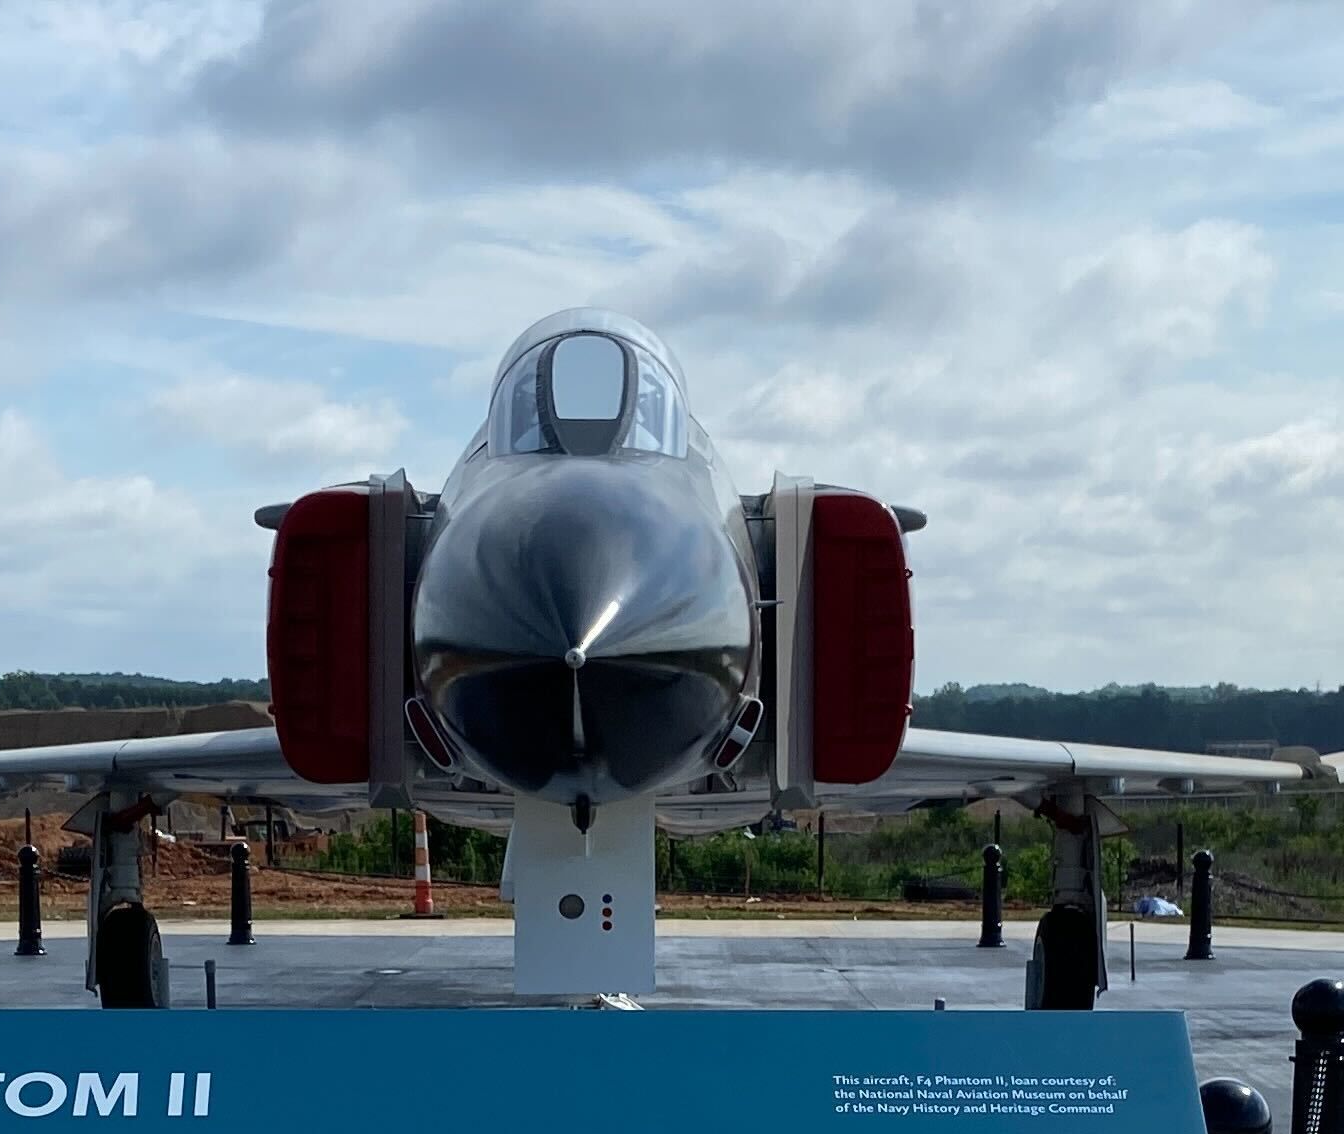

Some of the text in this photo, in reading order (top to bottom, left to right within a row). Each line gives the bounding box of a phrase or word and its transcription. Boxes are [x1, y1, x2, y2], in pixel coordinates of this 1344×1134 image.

[832, 1075, 860, 1085] This
[863, 1074, 914, 1087] aircraft,
[916, 1076, 932, 1087] F4
[935, 1075, 992, 1086] Phantom
[995, 1076, 1008, 1087] II,
[1010, 1076, 1038, 1086] loan
[1041, 1077, 1096, 1088] courtesy
[168, 1072, 211, 1116] II
[834, 1088, 1128, 1100] the National Naval Aviation Museum on behalf
[835, 1102, 1114, 1116] of the Navy History and Heritage Command
